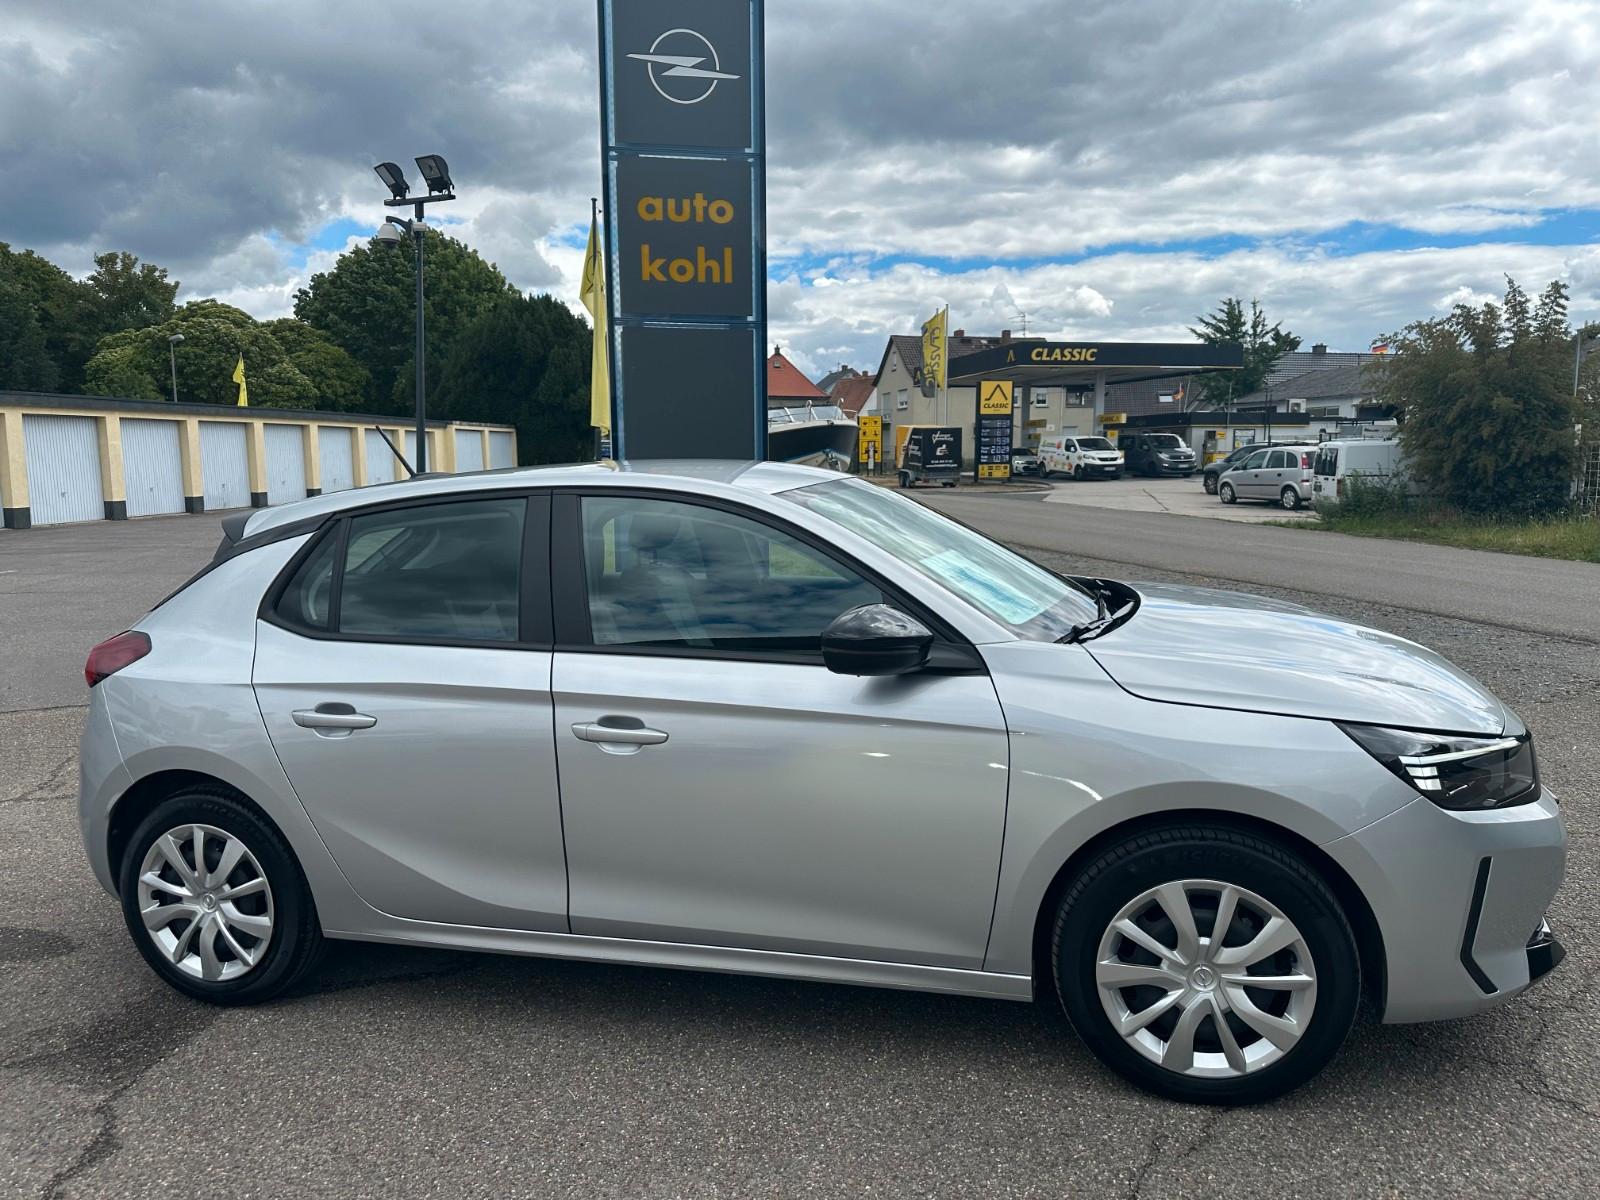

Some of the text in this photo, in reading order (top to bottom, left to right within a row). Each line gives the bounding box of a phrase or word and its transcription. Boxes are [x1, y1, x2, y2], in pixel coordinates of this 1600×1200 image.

[637, 192, 734, 224] auto
[640, 243, 733, 284] kohl
[1031, 348, 1098, 361] CLASSIC
